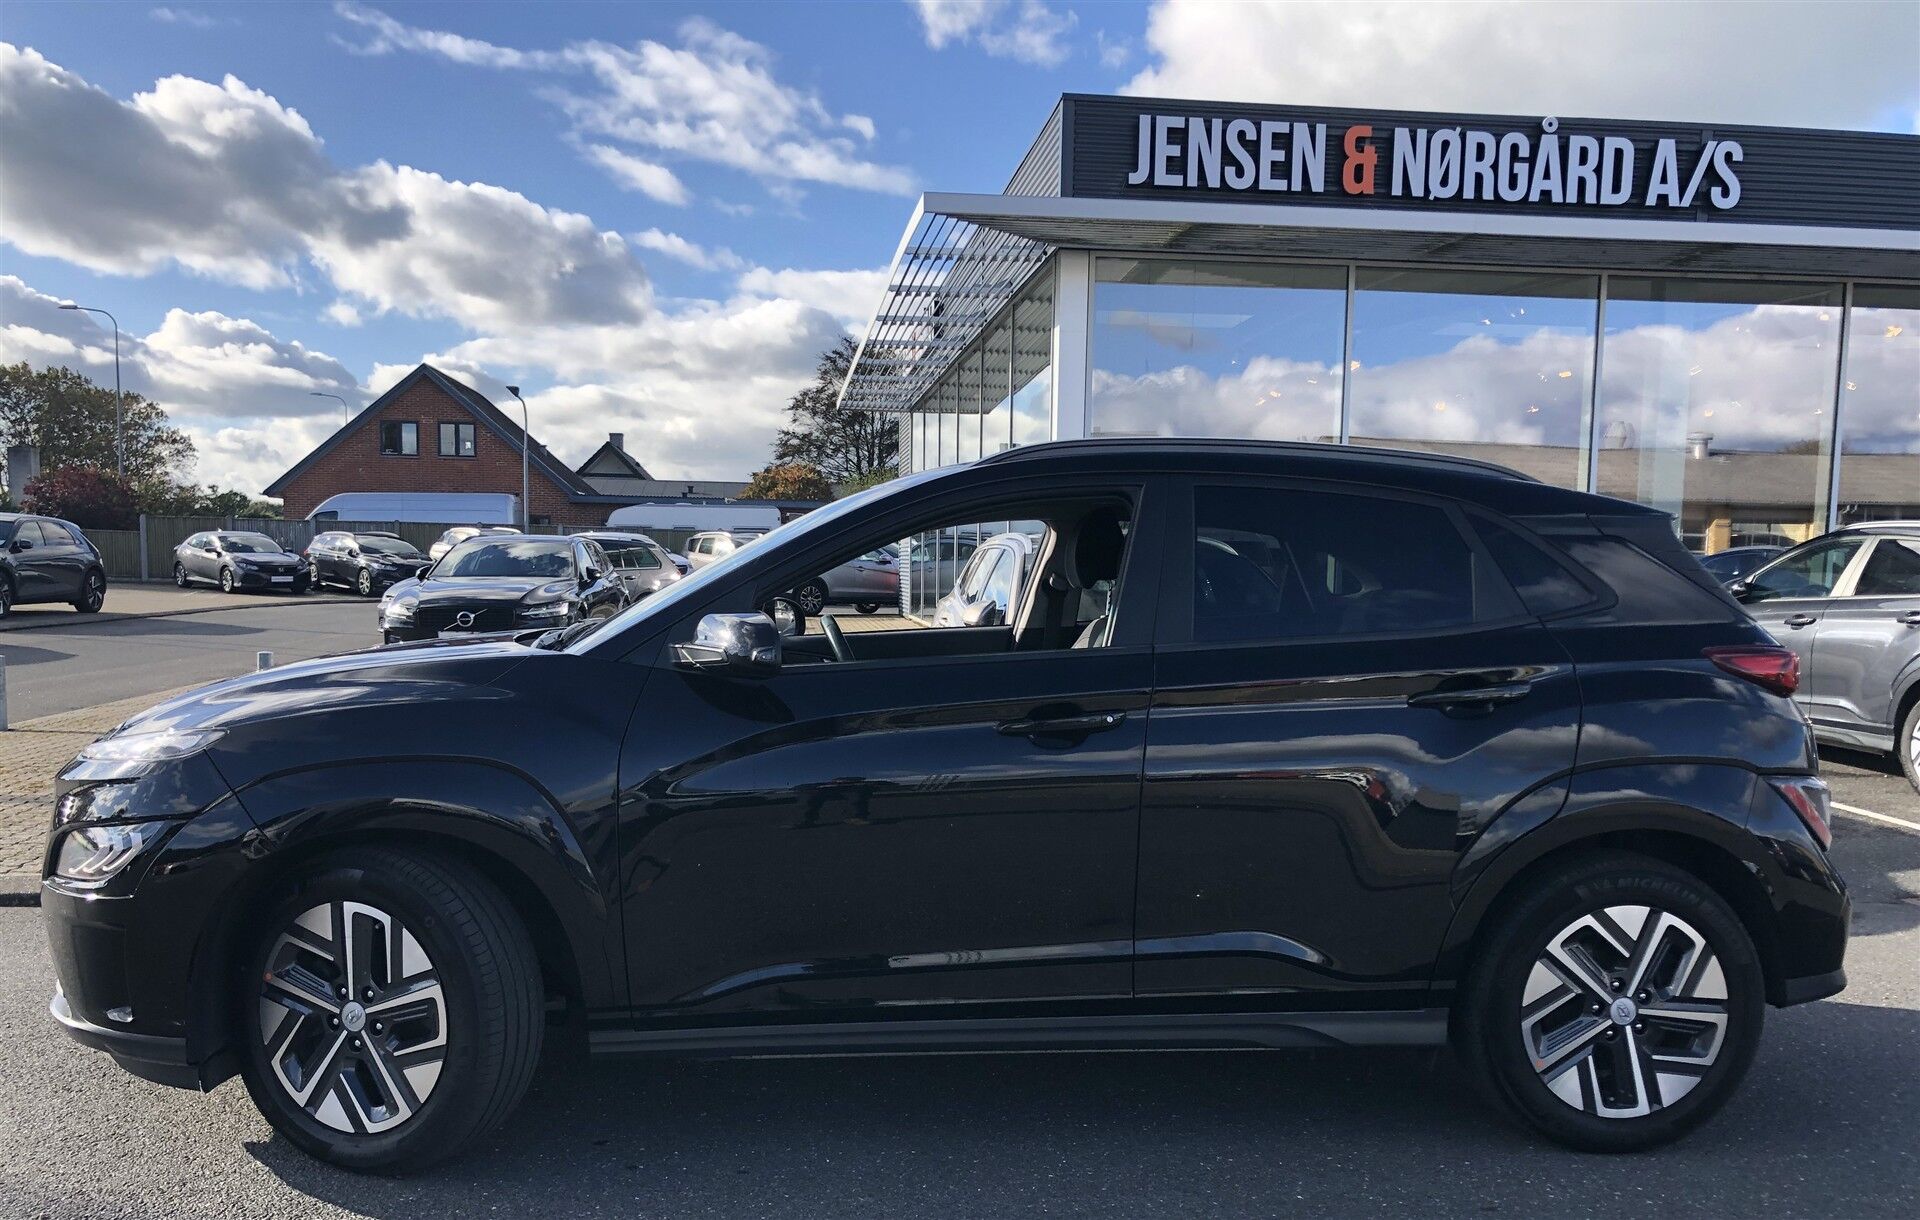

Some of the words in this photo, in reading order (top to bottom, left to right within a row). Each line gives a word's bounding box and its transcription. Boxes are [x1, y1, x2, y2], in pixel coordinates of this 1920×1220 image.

[1128, 114, 1327, 193] JENSEN
[1342, 125, 1378, 195] &
[1391, 115, 1635, 206] NØRGÅRD
[1645, 138, 1744, 210] A/S
